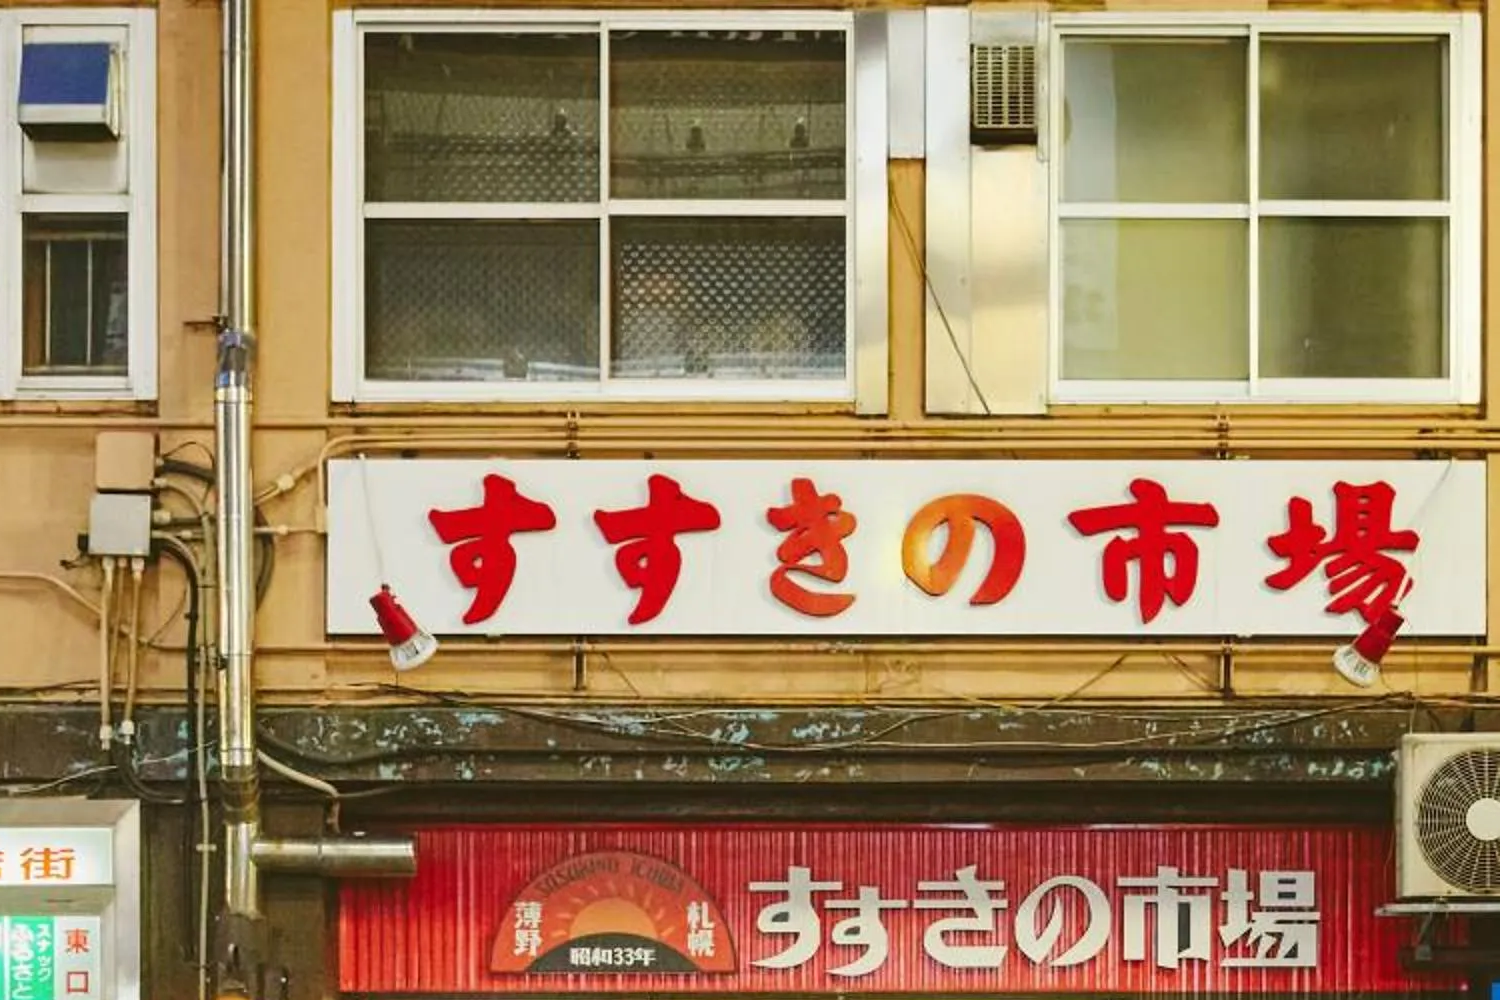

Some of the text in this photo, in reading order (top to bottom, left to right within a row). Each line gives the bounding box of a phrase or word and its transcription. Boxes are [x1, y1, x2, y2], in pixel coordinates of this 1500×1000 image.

[428, 474, 1420, 625] すすきの市場
[514, 901, 543, 957] 薄野
[687, 901, 715, 957] 札幌
[748, 865, 1321, 975] すすきの市場
[36, 924, 51, 983] スナック
[65, 929, 90, 994] 東口
[569, 947, 656, 967] 昭和33年
